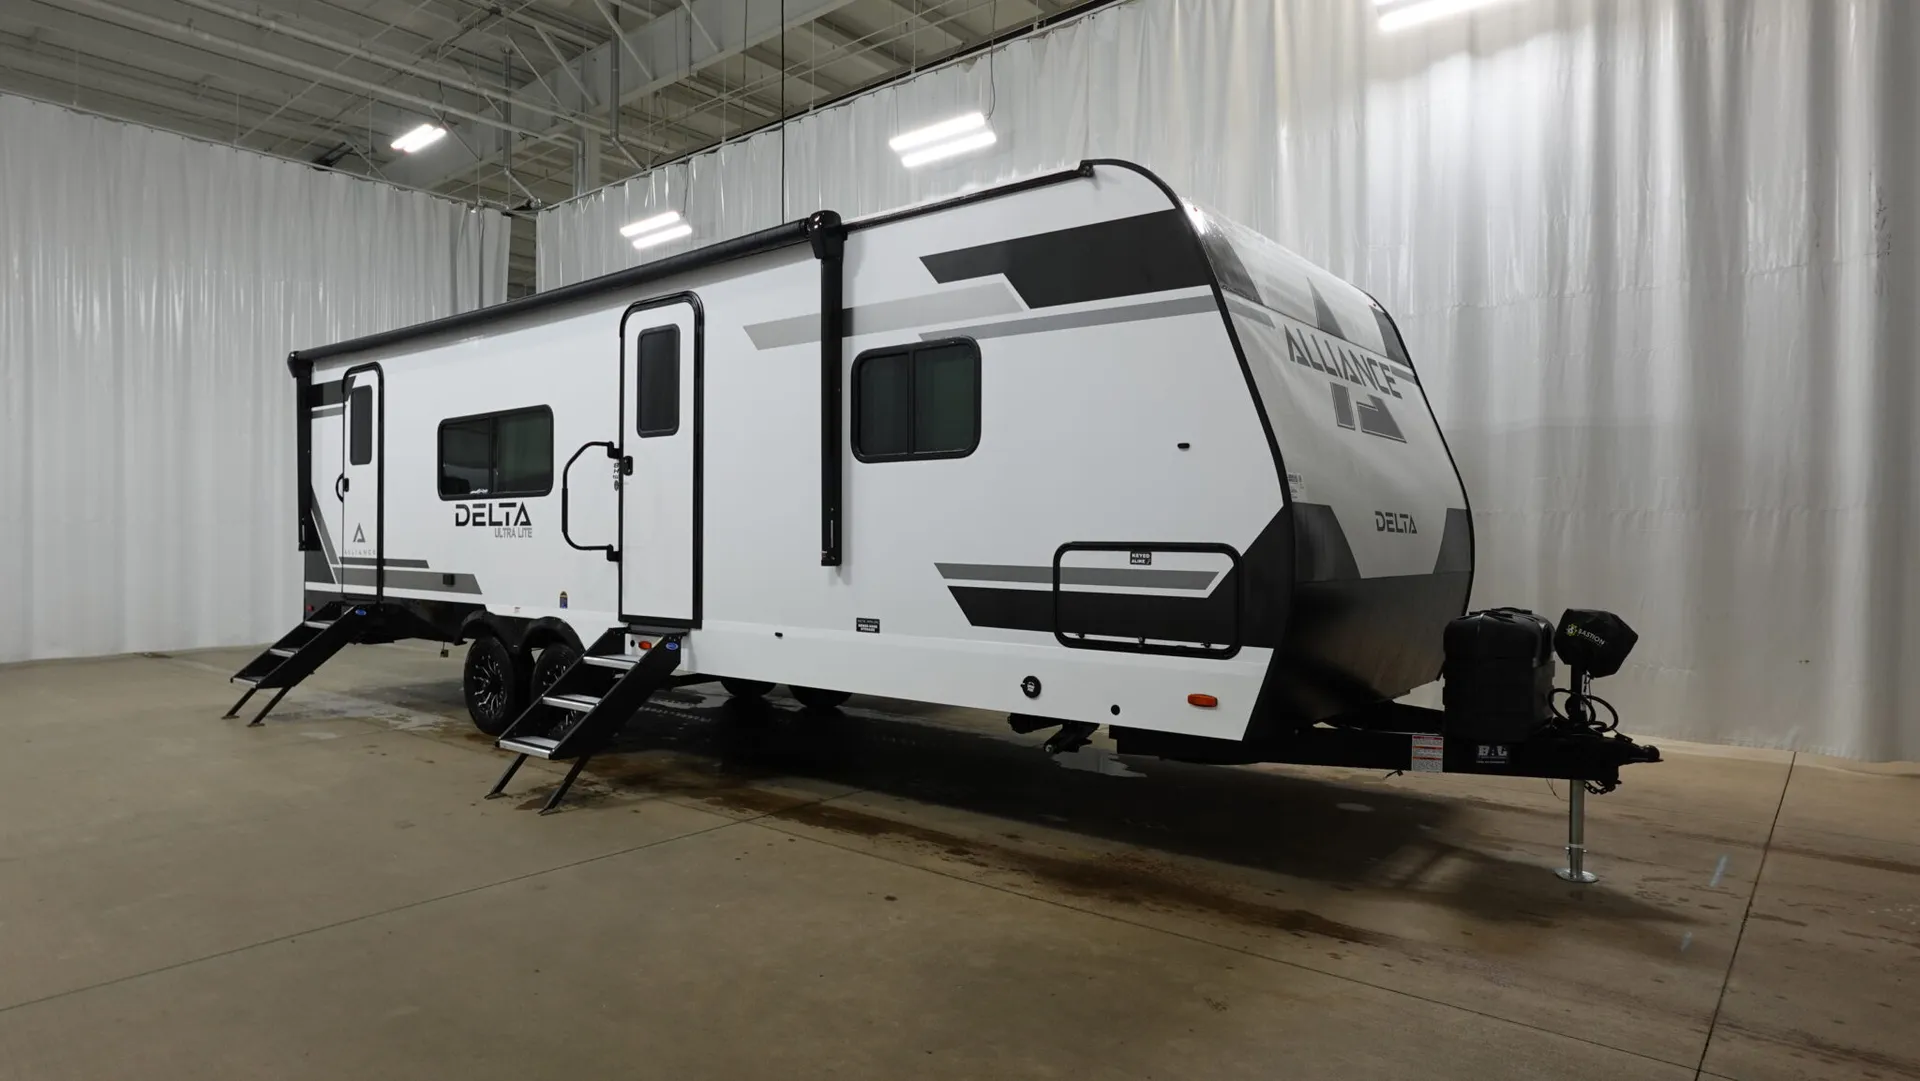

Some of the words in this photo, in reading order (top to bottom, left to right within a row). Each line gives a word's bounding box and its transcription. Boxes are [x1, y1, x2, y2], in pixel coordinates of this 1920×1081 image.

[1283, 323, 1403, 400] ALLIANCE
[454, 501, 532, 526] DELTA
[1374, 510, 1418, 534] DELTA
[494, 527, 516, 538] ULTRA
[517, 526, 533, 538] LITE
